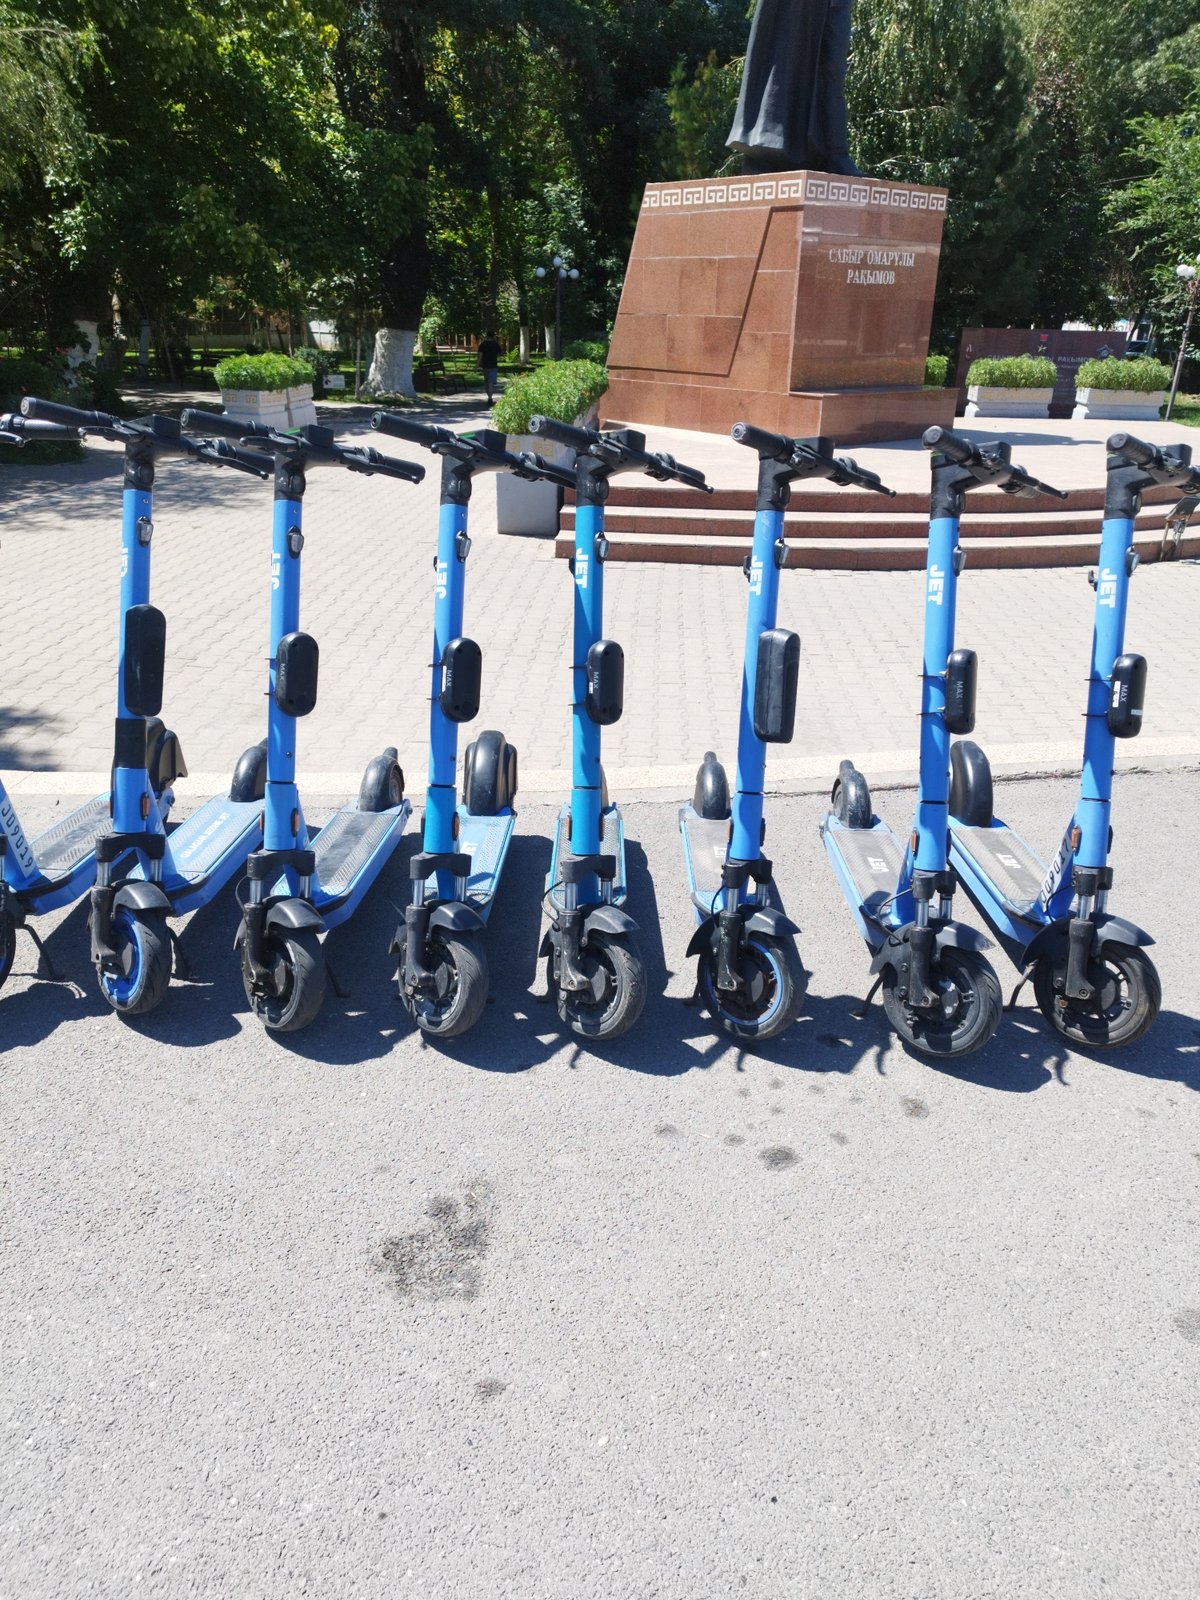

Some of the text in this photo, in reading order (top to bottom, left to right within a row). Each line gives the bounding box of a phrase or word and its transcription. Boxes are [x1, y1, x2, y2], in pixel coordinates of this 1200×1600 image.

[828, 248, 864, 264] САБЫР
[846, 269, 895, 286] РАҚЫМОВ
[436, 559, 448, 600] JET
[575, 547, 589, 589] JET
[749, 555, 764, 596] JET
[928, 564, 945, 606] JET
[1099, 567, 1118, 609] JET
[956, 681, 964, 699] MAX
[1119, 684, 1129, 702] MAX
[1, 803, 34, 869] J09019
[867, 856, 889, 873] JET
[995, 853, 1021, 869] JET
